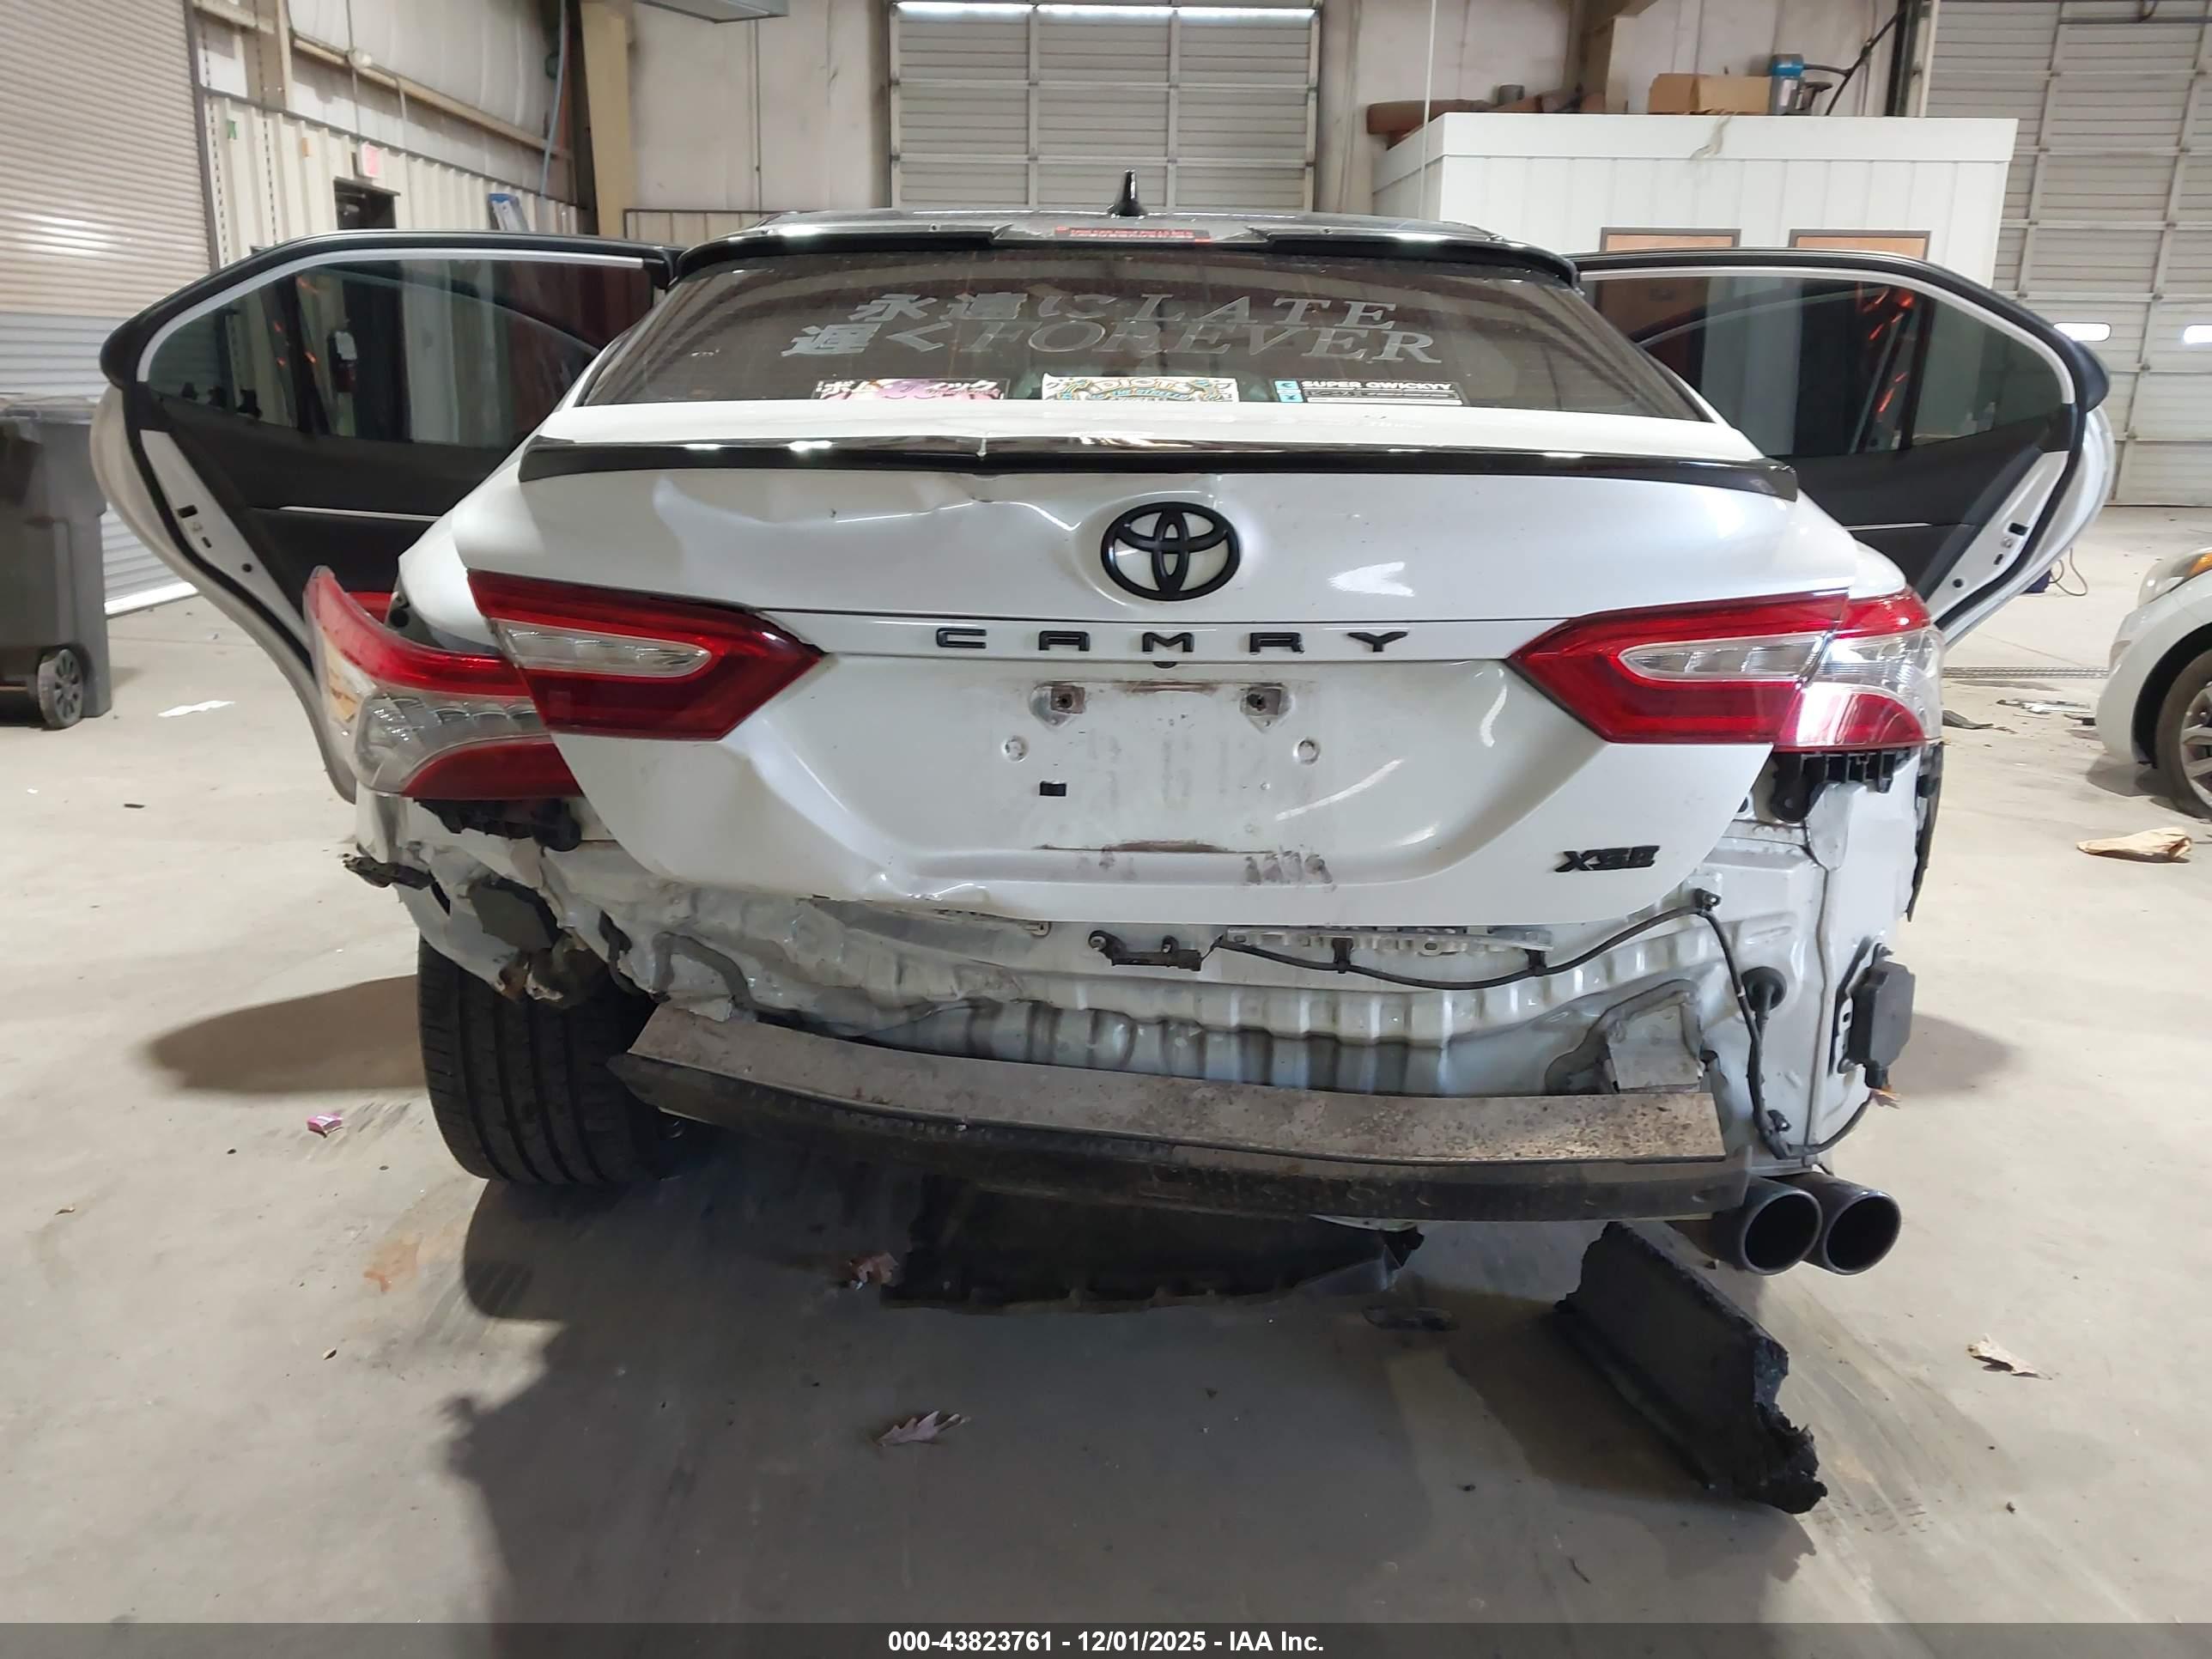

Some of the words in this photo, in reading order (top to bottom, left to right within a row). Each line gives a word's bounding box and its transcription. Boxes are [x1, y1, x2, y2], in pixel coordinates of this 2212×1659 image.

[1125, 294, 1397, 330] LATE
[959, 321, 1442, 363] FOREVER
[936, 628, 1408, 653] CAMRY
